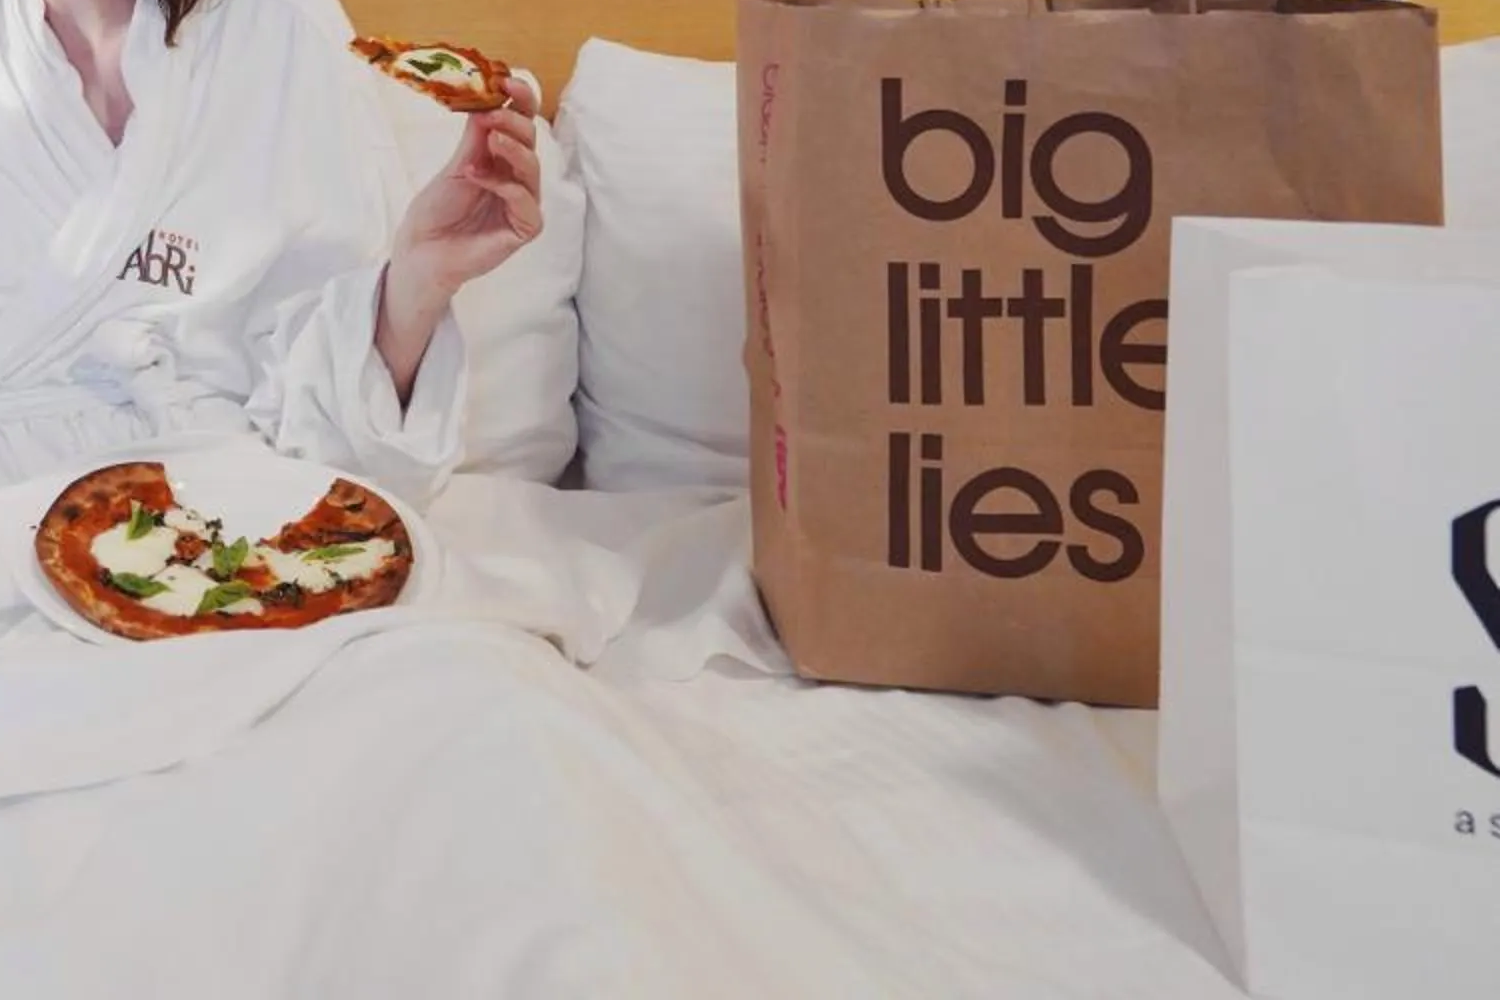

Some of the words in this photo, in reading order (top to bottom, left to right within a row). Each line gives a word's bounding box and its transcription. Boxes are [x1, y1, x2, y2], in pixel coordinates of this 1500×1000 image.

[159, 231, 199, 252] HOTEL
[880, 77, 1154, 259] big
[887, 261, 1168, 413] little
[887, 431, 1146, 584] lies
